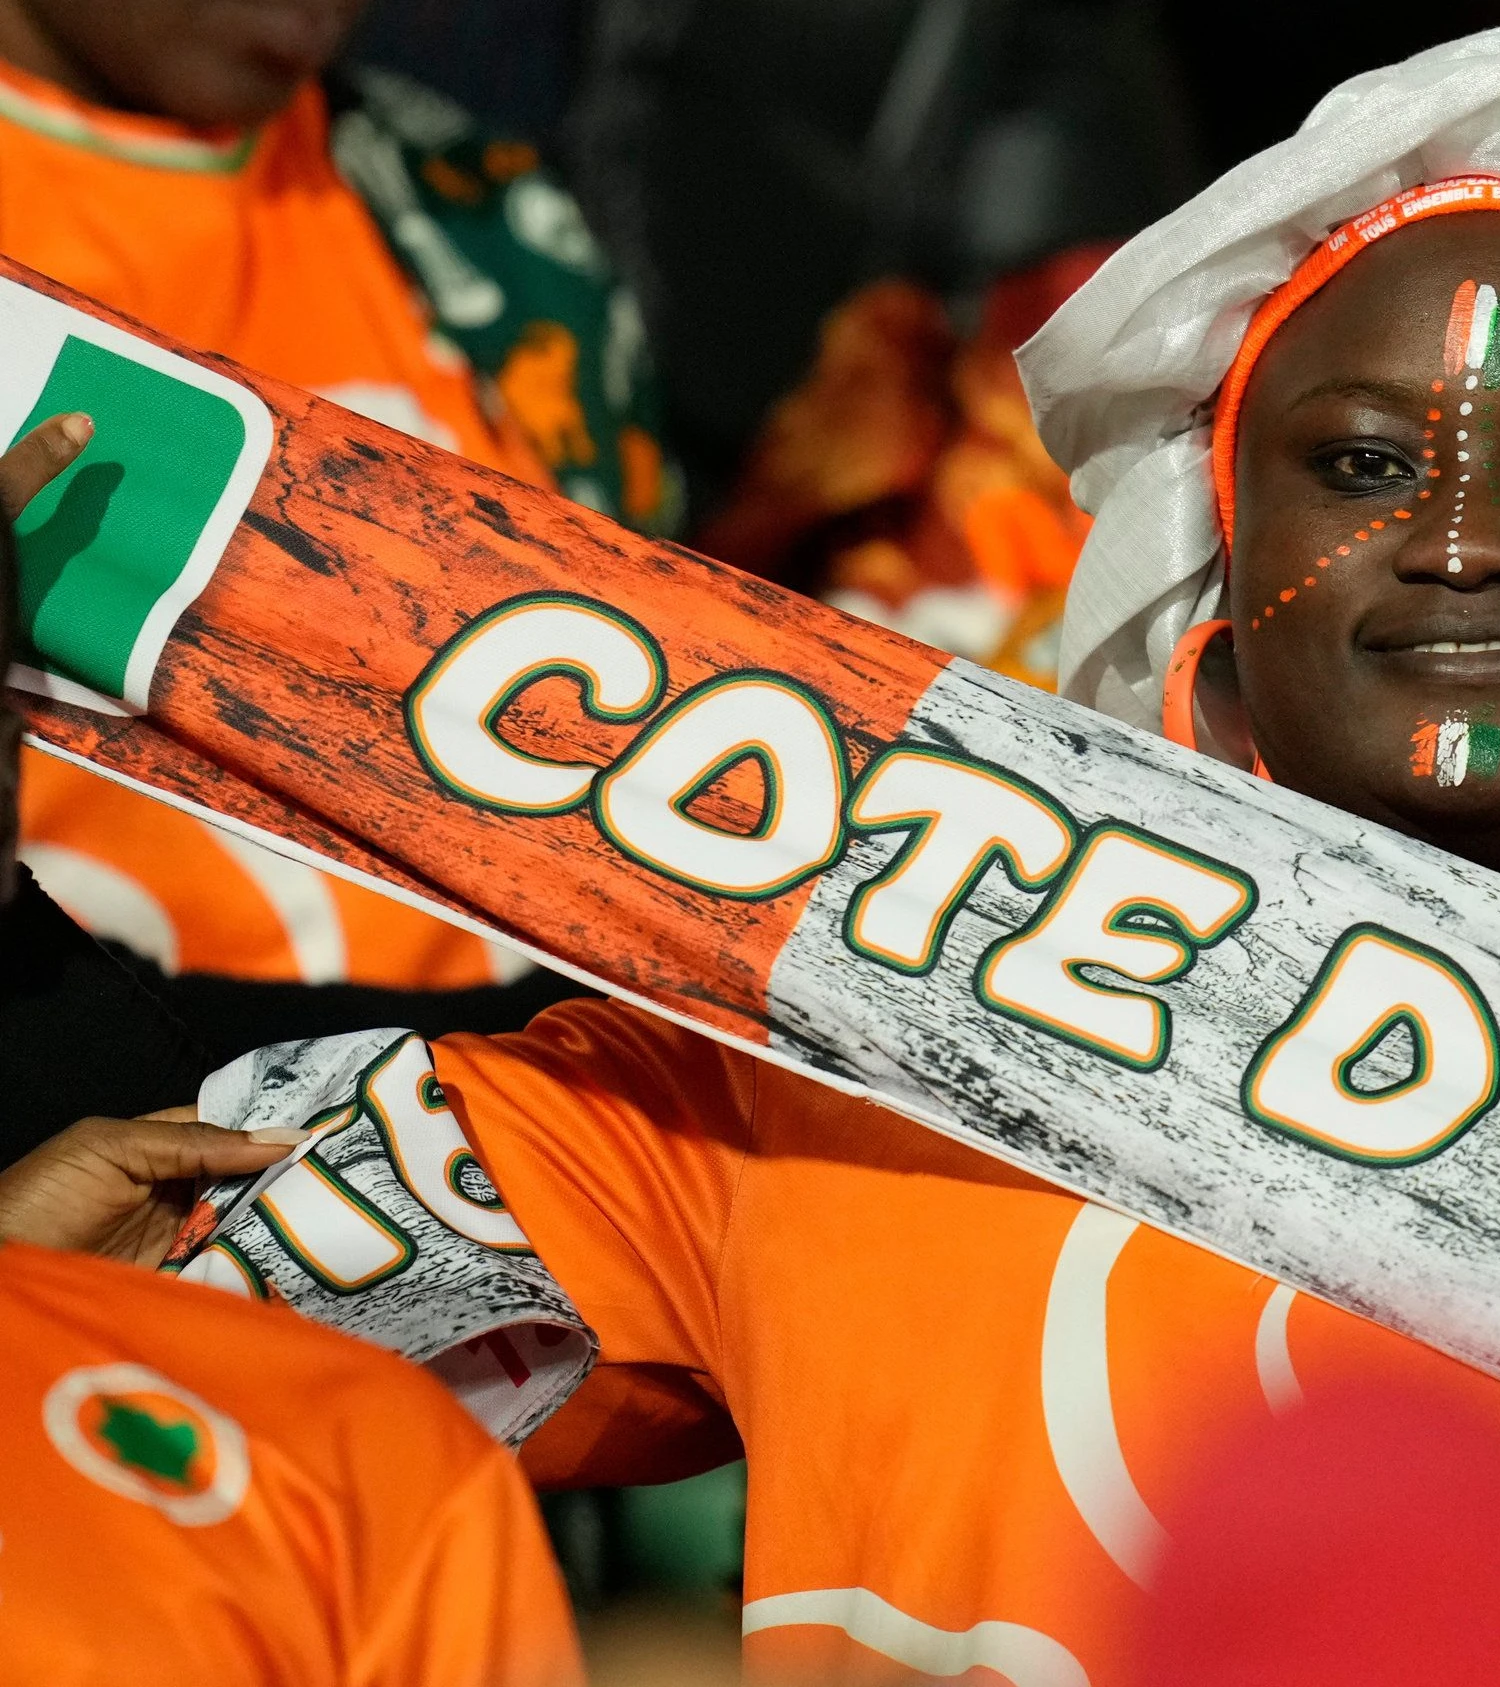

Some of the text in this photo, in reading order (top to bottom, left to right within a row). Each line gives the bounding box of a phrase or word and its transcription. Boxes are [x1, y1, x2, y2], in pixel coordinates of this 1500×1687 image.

[1327, 231, 1349, 251] UN
[1396, 191, 1415, 203] UN
[1359, 213, 1397, 242] TOUS
[1402, 186, 1484, 218] ENSEMBLE
[403, 590, 1260, 1074] COTE
